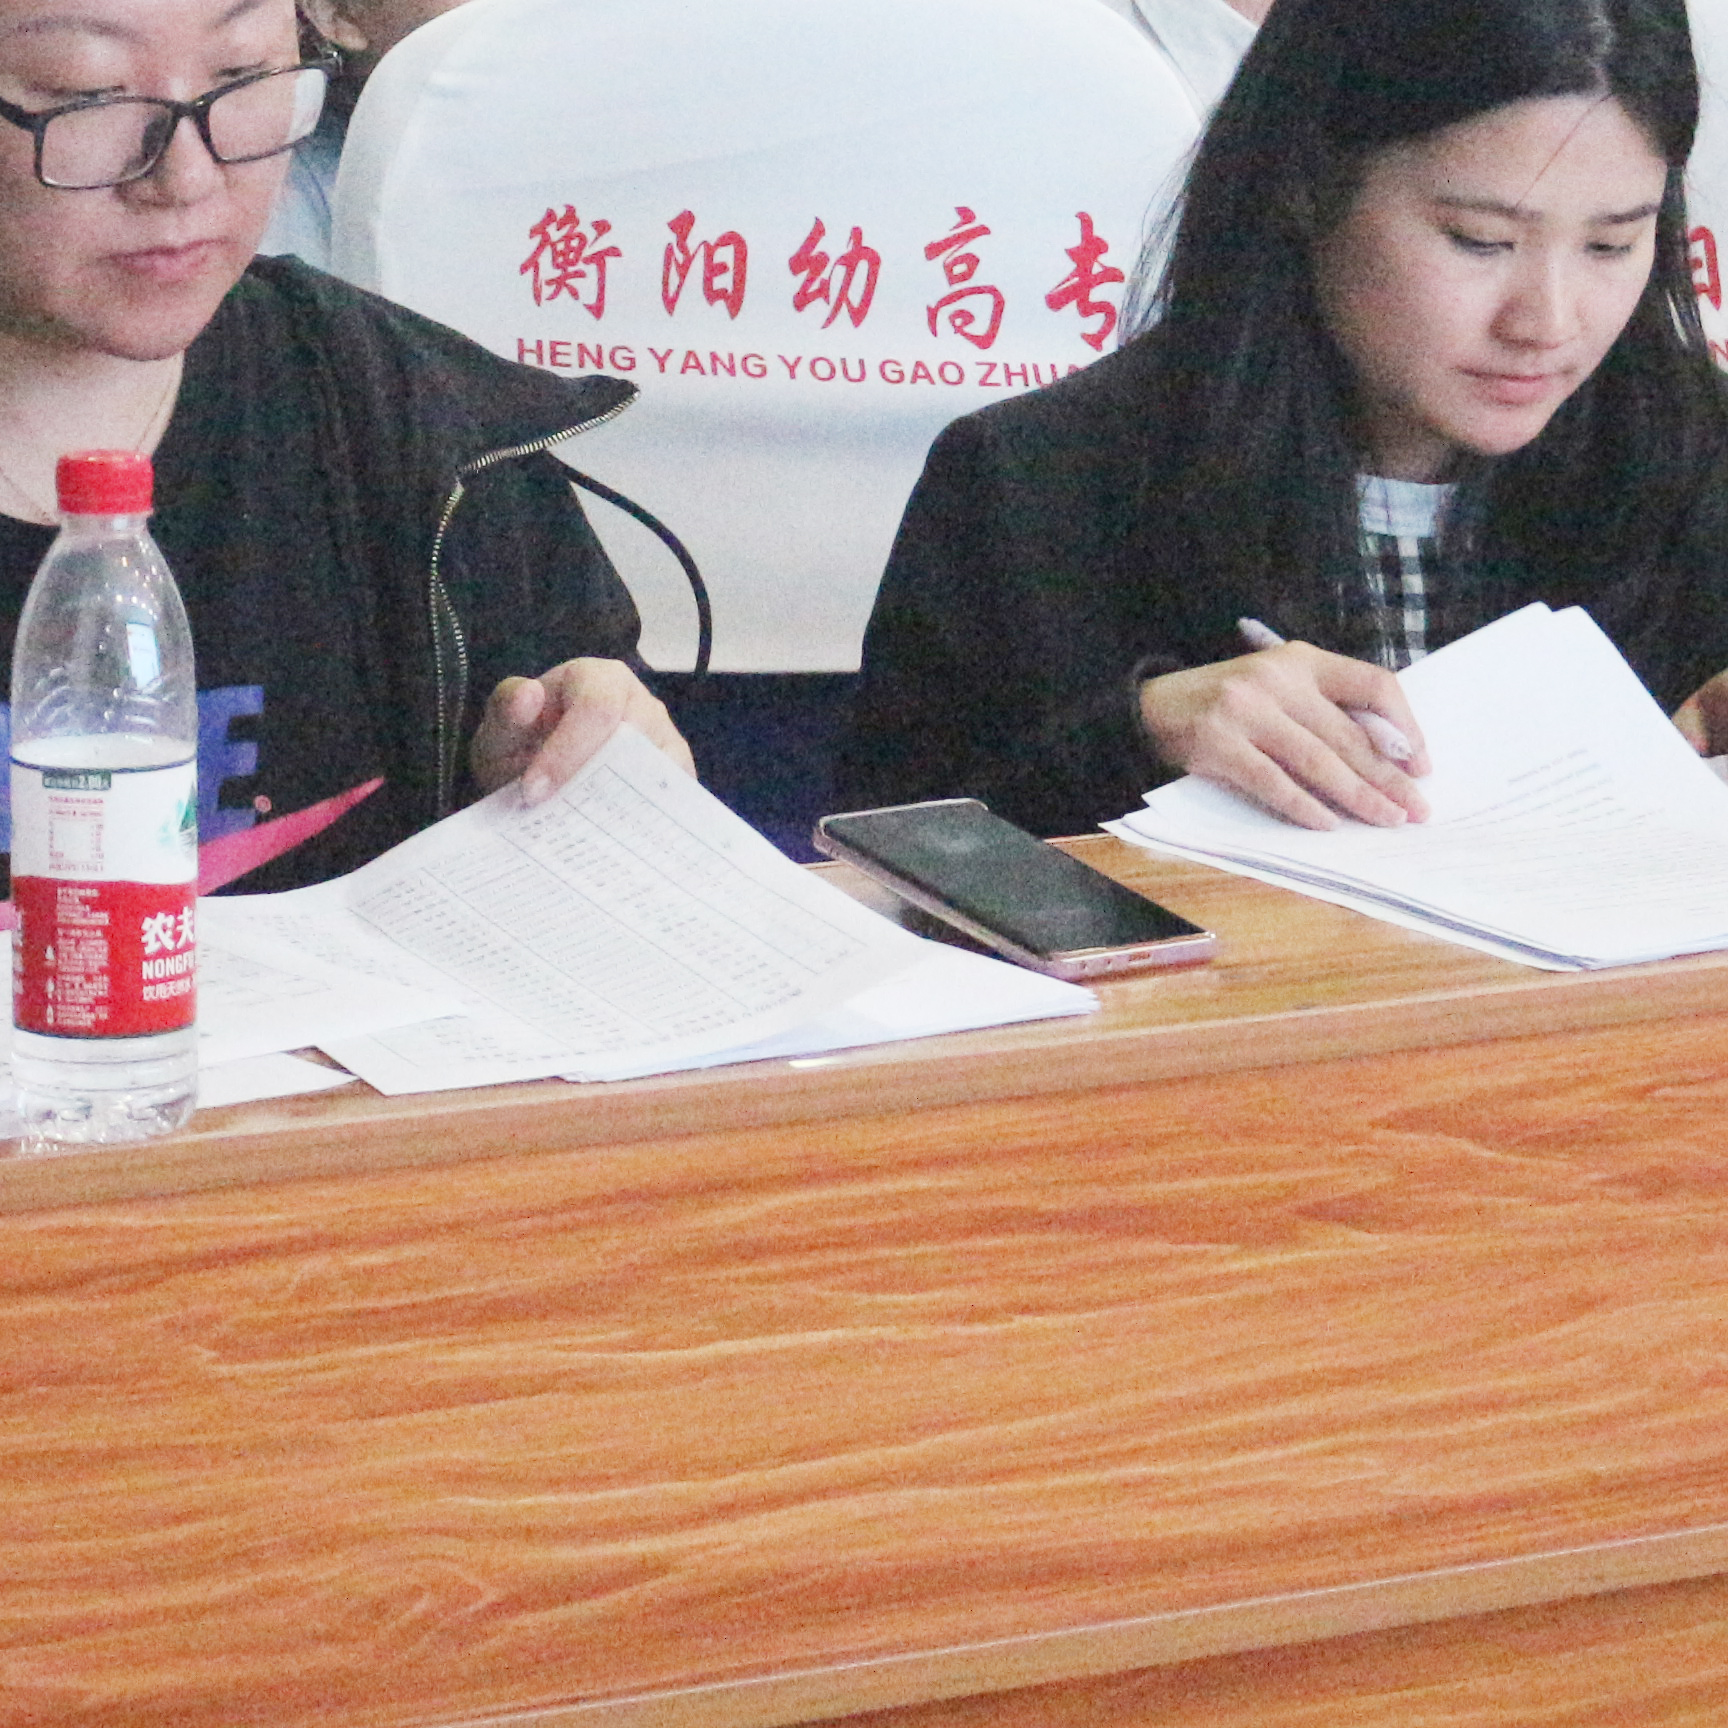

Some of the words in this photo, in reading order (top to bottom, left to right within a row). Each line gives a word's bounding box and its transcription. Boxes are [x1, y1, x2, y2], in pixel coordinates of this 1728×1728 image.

[519, 204, 1125, 353] 衡阳幼高专
[516, 337, 637, 372] HENG
[647, 347, 769, 379] YANG
[777, 353, 867, 383] YOU
[878, 358, 966, 386] GAO
[974, 361, 1088, 389] ZHU
